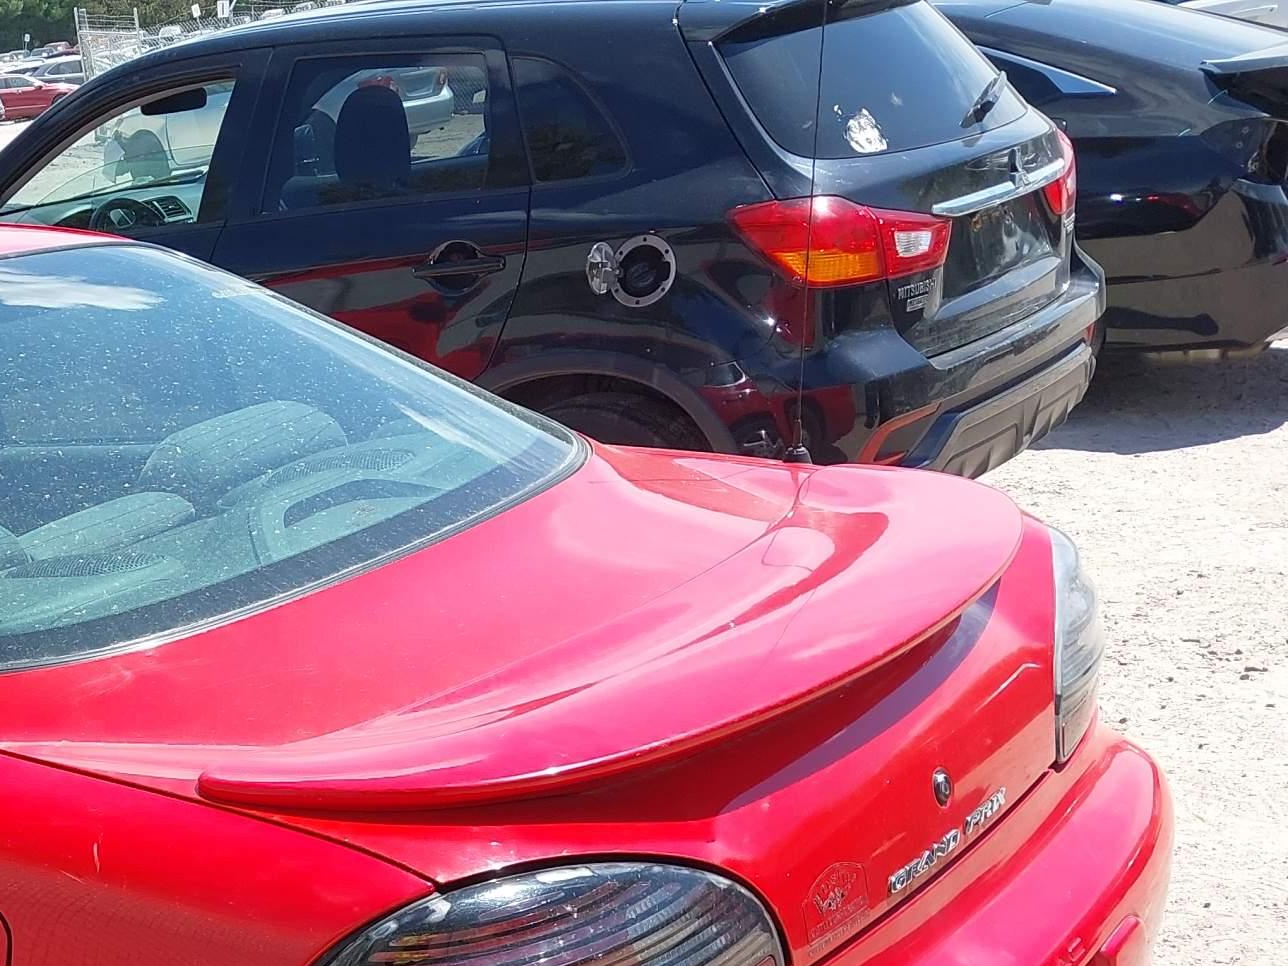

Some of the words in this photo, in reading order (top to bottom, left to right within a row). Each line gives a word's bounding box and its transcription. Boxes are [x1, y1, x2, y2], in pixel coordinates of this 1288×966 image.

[897, 278, 937, 300] MITSUBISHI
[888, 829, 960, 893] GRAND
[964, 787, 1006, 833] PRIX
